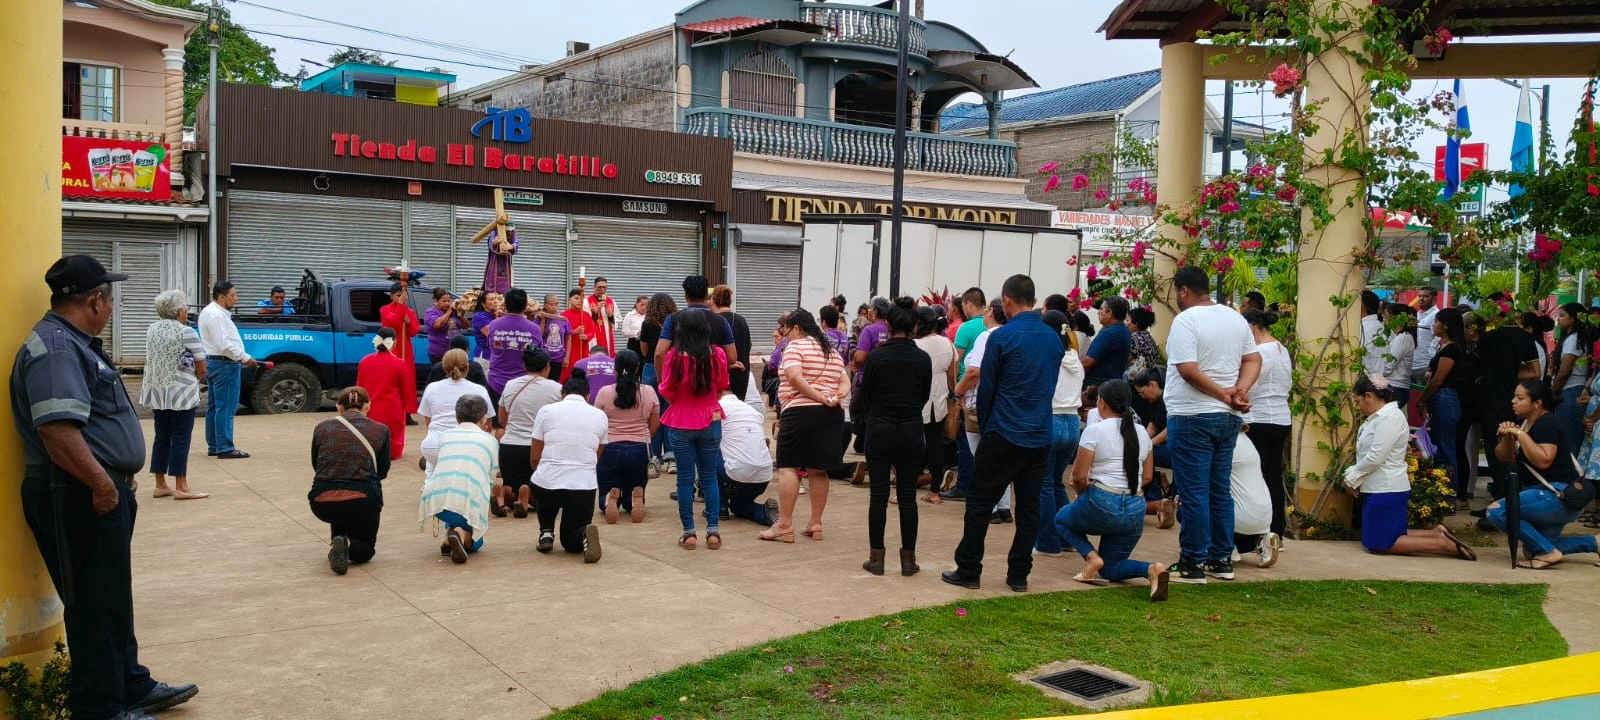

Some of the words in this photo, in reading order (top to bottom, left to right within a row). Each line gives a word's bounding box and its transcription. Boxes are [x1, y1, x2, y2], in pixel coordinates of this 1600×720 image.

[332, 132, 436, 164] Tienda
[447, 143, 475, 167] El
[484, 146, 618, 179] Baratillo
[655, 171, 679, 183] 8949
[681, 173, 703, 185] 5311
[623, 200, 667, 214] SAMSUNG
[766, 195, 864, 223] TIENDA
[1059, 212, 1110, 225] VARIEDADES
[244, 333, 284, 341] SEGURIDAD
